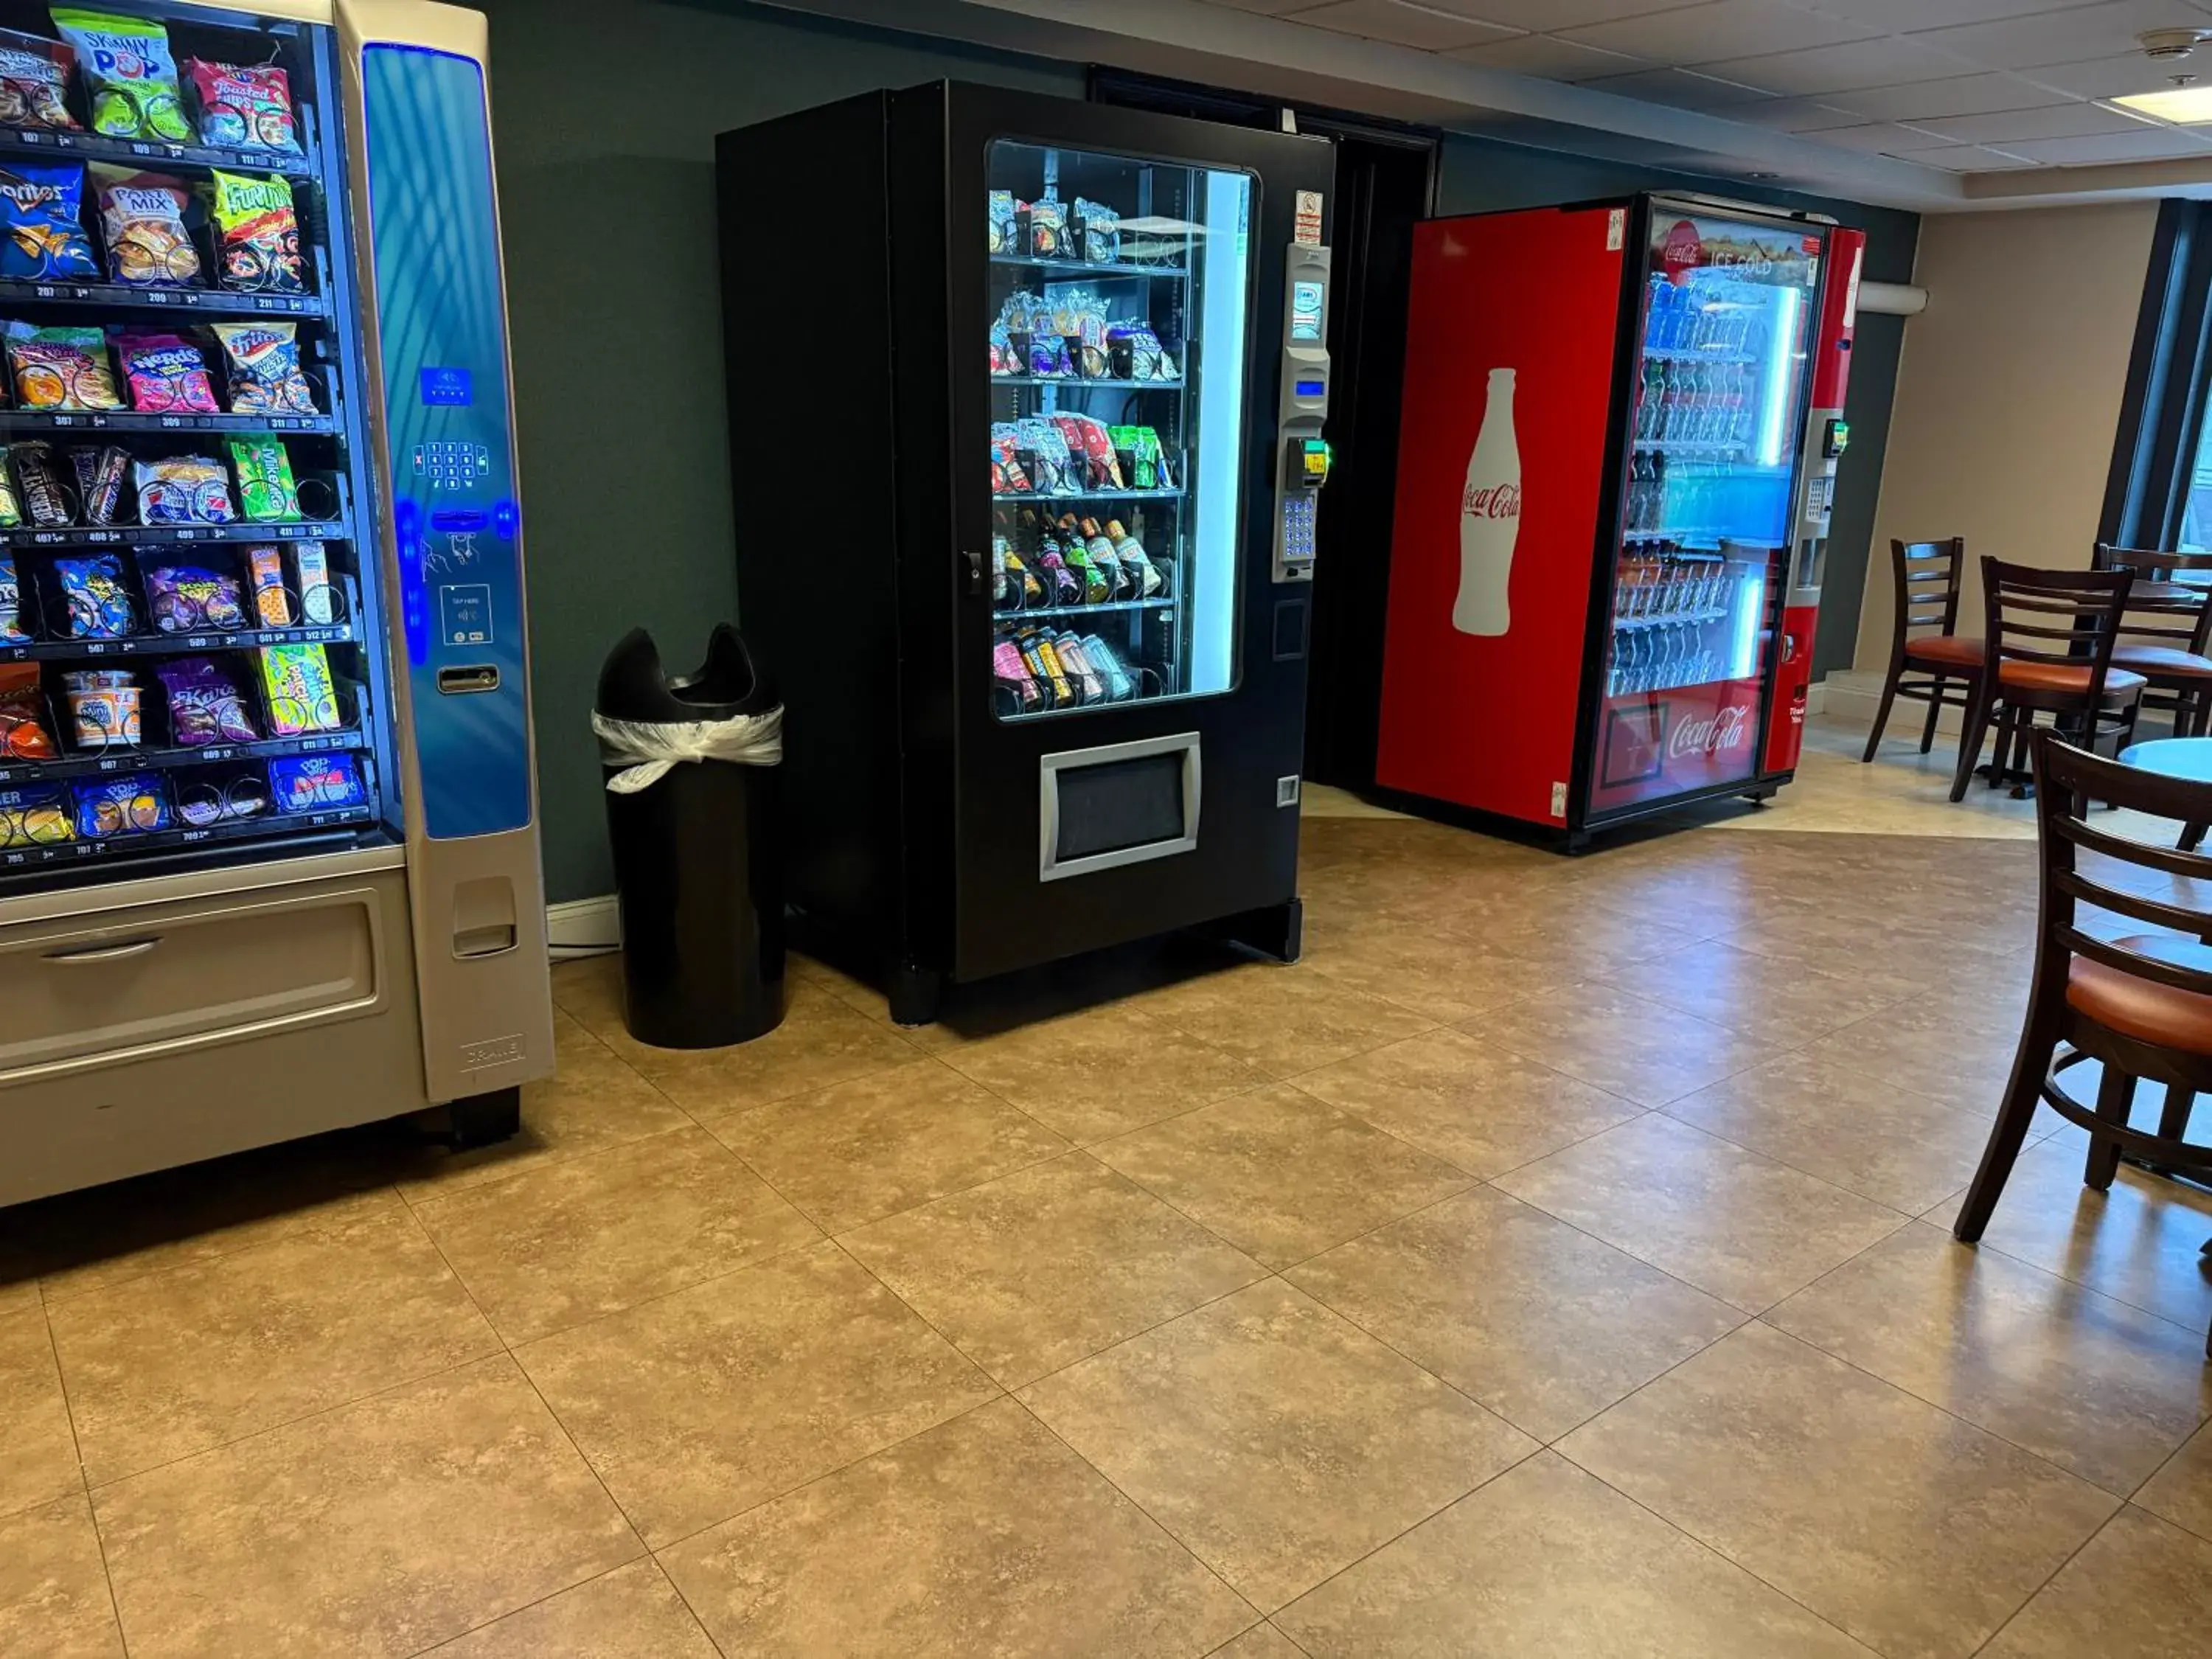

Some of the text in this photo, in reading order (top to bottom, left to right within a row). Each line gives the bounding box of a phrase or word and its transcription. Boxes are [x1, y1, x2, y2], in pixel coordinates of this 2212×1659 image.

[0, 184, 64, 201] oritos
[131, 198, 168, 210] MIX
[1711, 251, 1772, 276] ICE COLD
[1463, 483, 1520, 520] Coca-Cola
[1669, 704, 1750, 759] Coca-Cola
